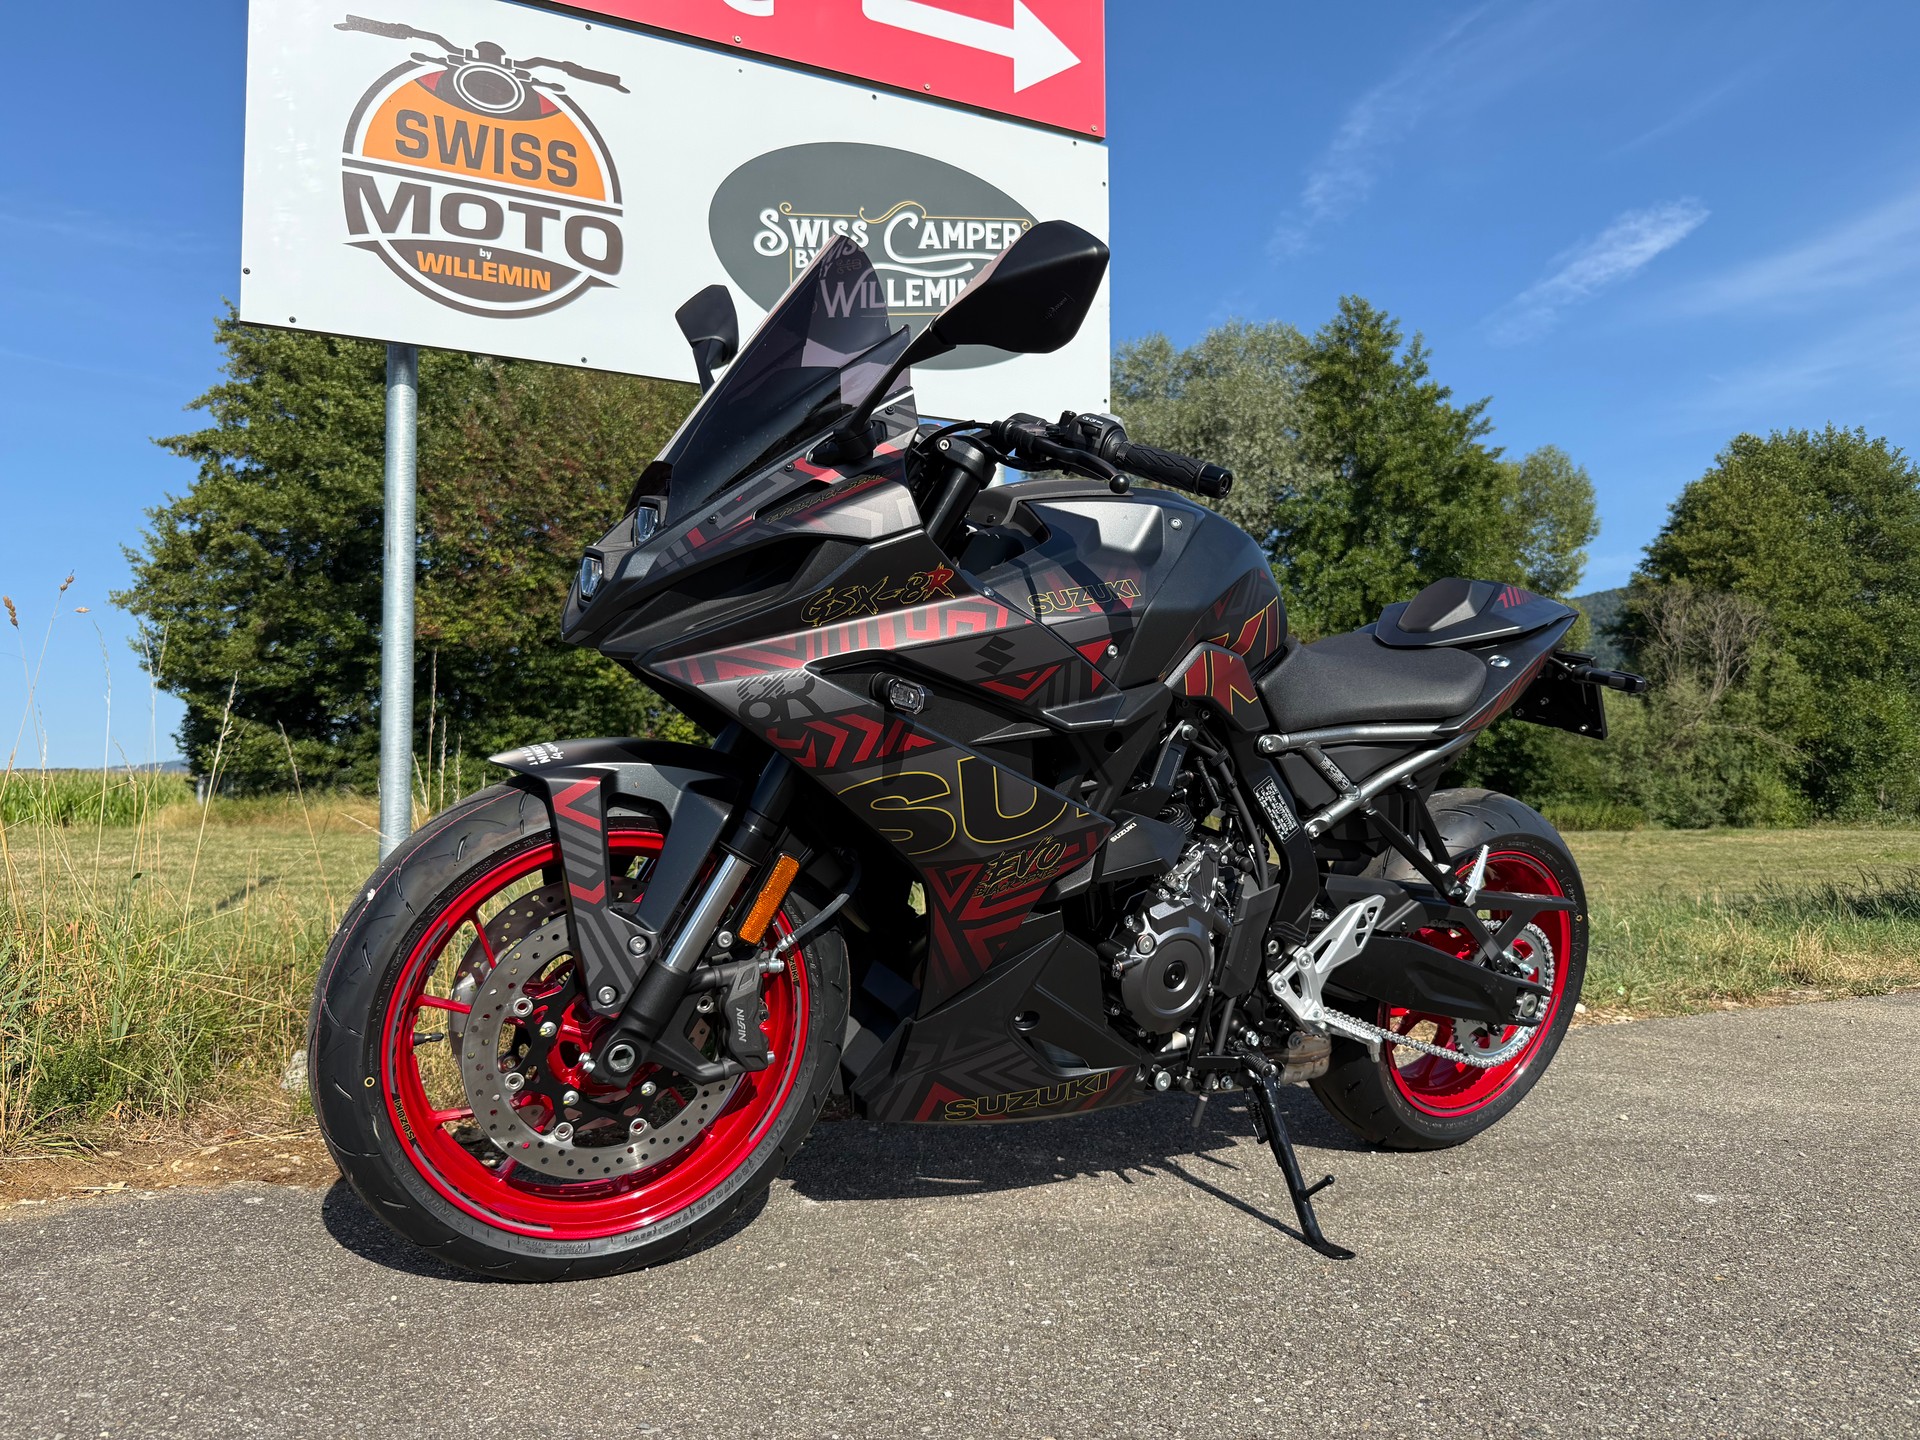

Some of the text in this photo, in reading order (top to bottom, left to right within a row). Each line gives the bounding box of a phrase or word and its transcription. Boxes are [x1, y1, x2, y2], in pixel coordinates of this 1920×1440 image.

[396, 109, 577, 188] SWISS
[342, 171, 623, 275] MOTO
[416, 250, 551, 291] WILLEMIN
[479, 247, 492, 259] by
[801, 562, 956, 628] GSX-8R
[1027, 579, 1142, 615] SUZUKI
[837, 756, 1090, 856] SU
[1110, 822, 1137, 842] SUZUKI
[985, 835, 1067, 887] EVO
[394, 1098, 415, 1141] SUZUKI
[945, 1071, 1110, 1121] SUZUKI
